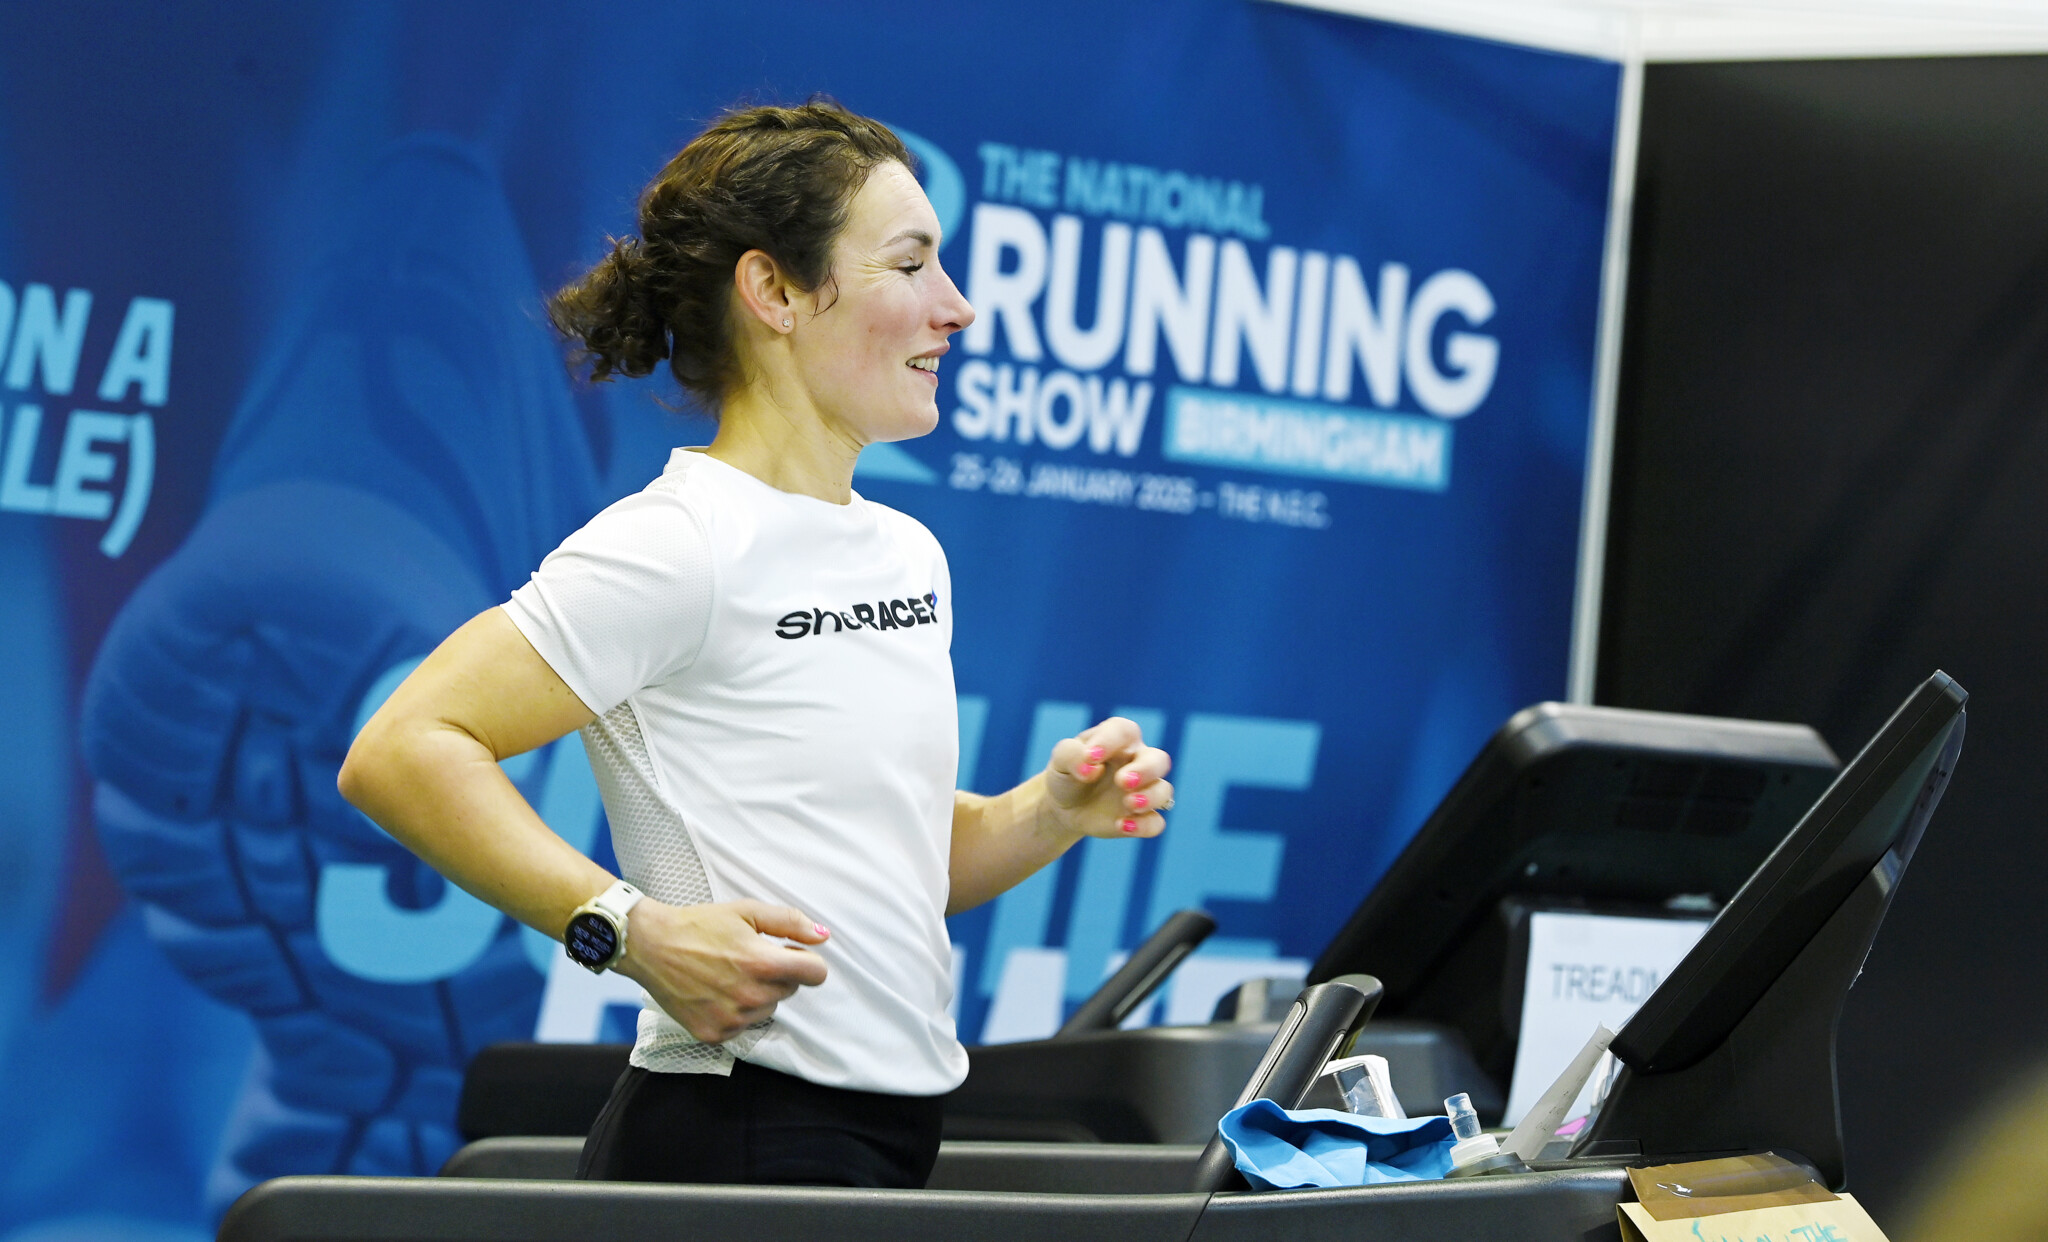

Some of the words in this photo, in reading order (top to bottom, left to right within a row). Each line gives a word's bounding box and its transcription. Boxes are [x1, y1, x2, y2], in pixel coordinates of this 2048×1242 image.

[977, 141, 1061, 209] THE
[1065, 157, 1271, 240] NATIONAL
[0, 278, 93, 396] N
[98, 296, 175, 405] A
[962, 202, 1499, 419] RUNNING
[952, 359, 1154, 457] SHOW
[1172, 395, 1446, 485] BIRMINGHAM
[1025, 463, 1136, 507] JANUARY
[1217, 481, 1264, 522] THE
